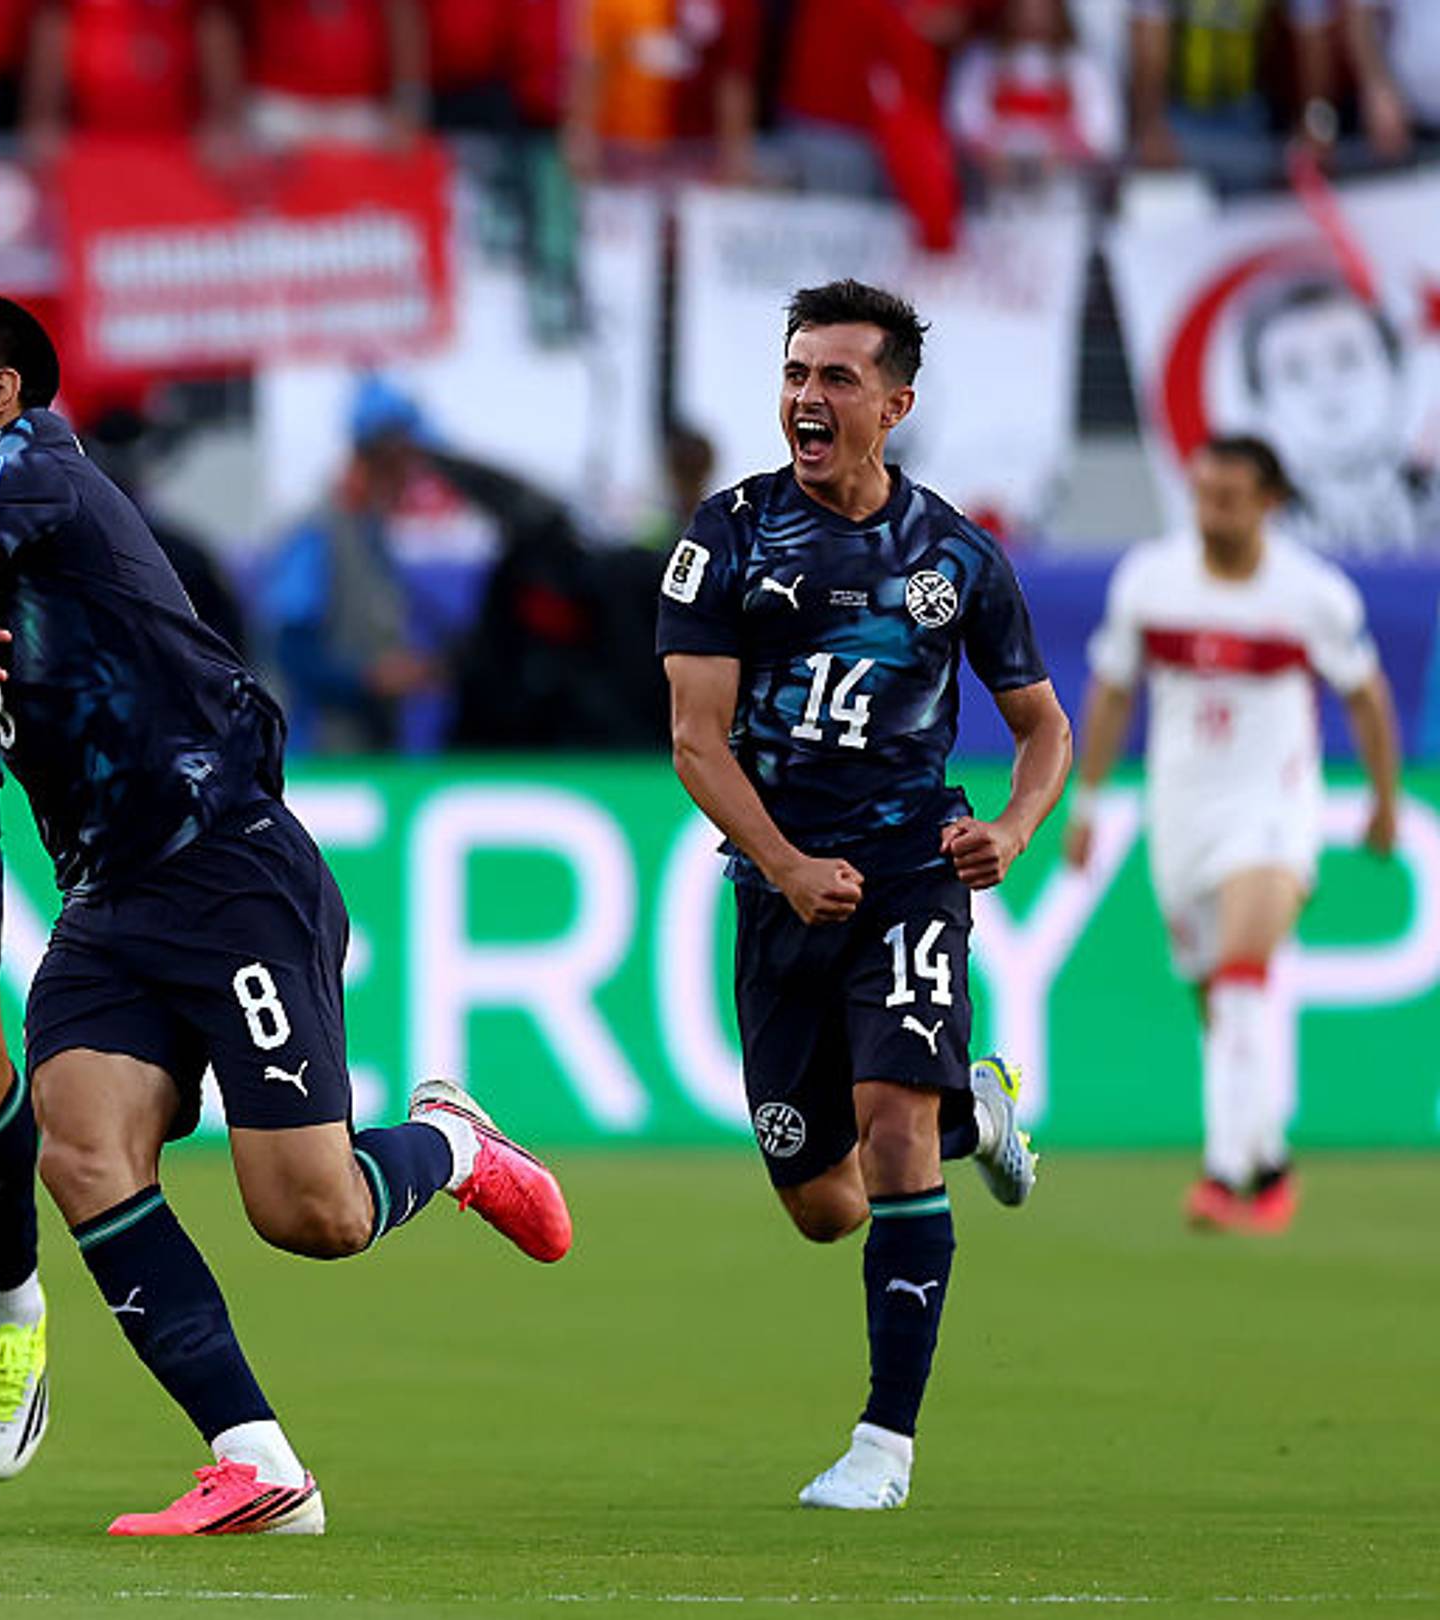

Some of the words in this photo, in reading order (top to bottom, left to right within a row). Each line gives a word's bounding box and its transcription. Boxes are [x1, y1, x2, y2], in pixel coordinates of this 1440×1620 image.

[789, 651, 877, 749] 14
[231, 961, 293, 1051] 8
[883, 918, 953, 1009] 14
